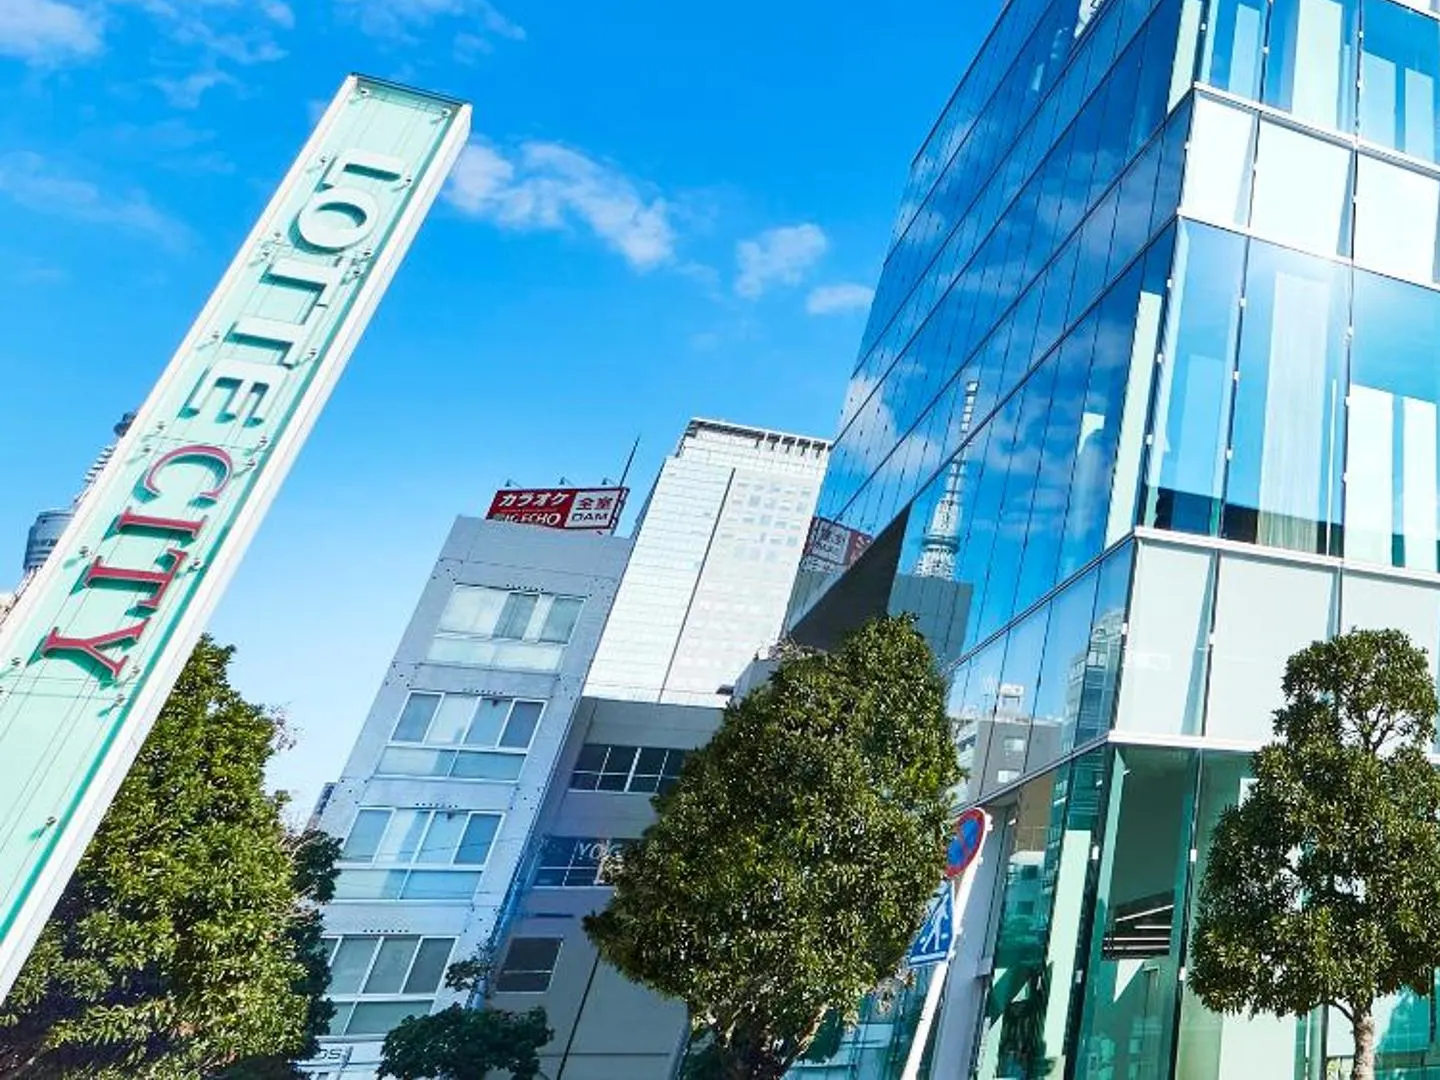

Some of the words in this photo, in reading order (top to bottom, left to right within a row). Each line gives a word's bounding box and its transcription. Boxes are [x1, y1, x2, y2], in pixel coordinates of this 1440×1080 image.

[181, 150, 406, 423] LOTTE
[42, 442, 235, 681] CITY
[499, 492, 570, 507] カラオケ
[572, 513, 608, 522] DAM
